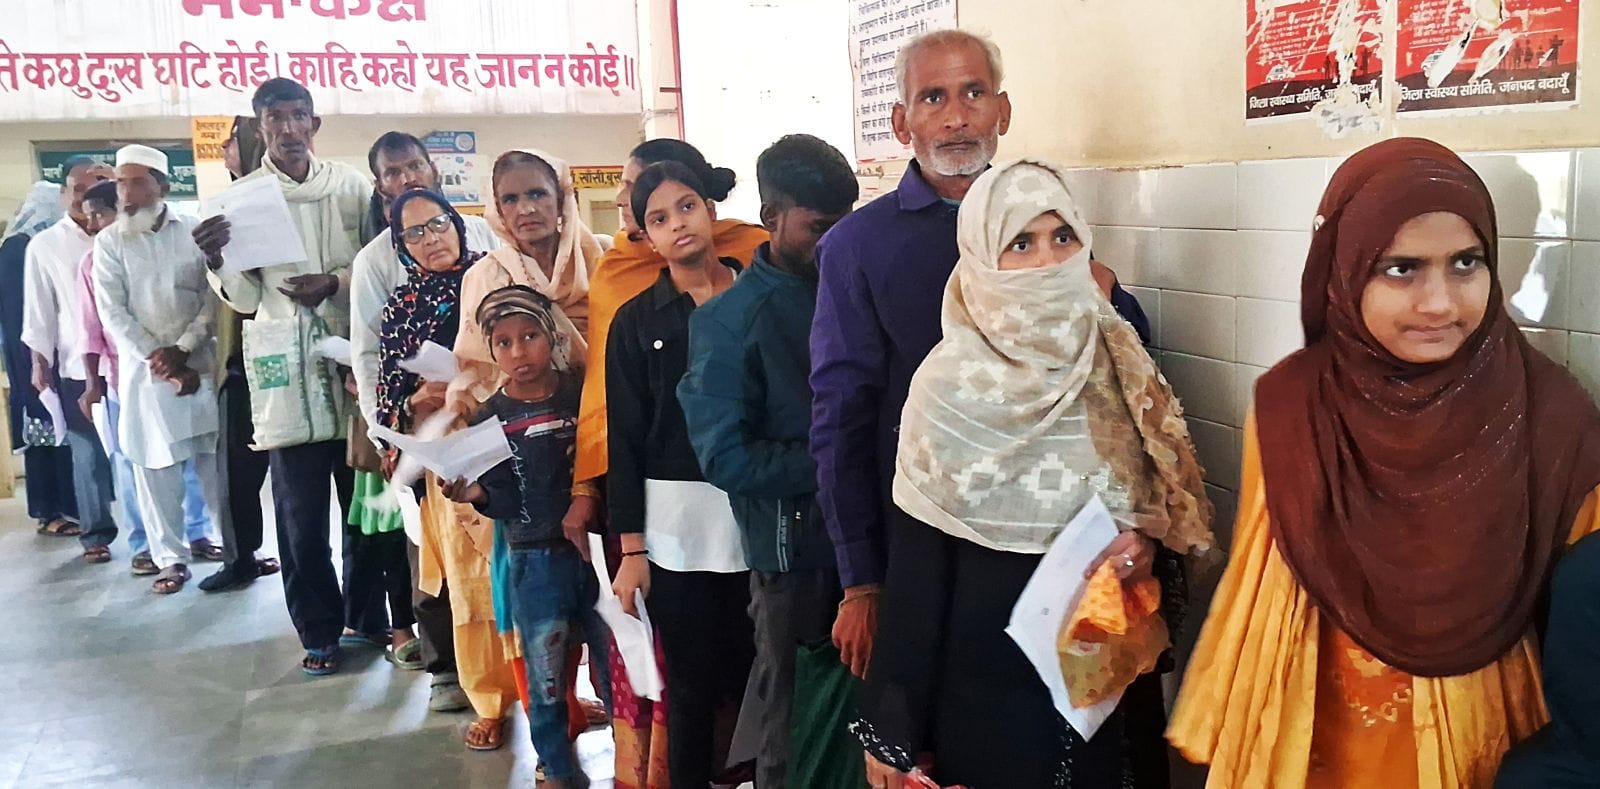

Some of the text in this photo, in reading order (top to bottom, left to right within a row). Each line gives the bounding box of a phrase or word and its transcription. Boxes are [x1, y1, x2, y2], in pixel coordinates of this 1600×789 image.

[22, 52, 92, 99] कछु
[147, 41, 211, 89] घटि
[287, 41, 363, 92] काहि
[360, 40, 418, 92] कहो
[422, 52, 473, 92] यह
